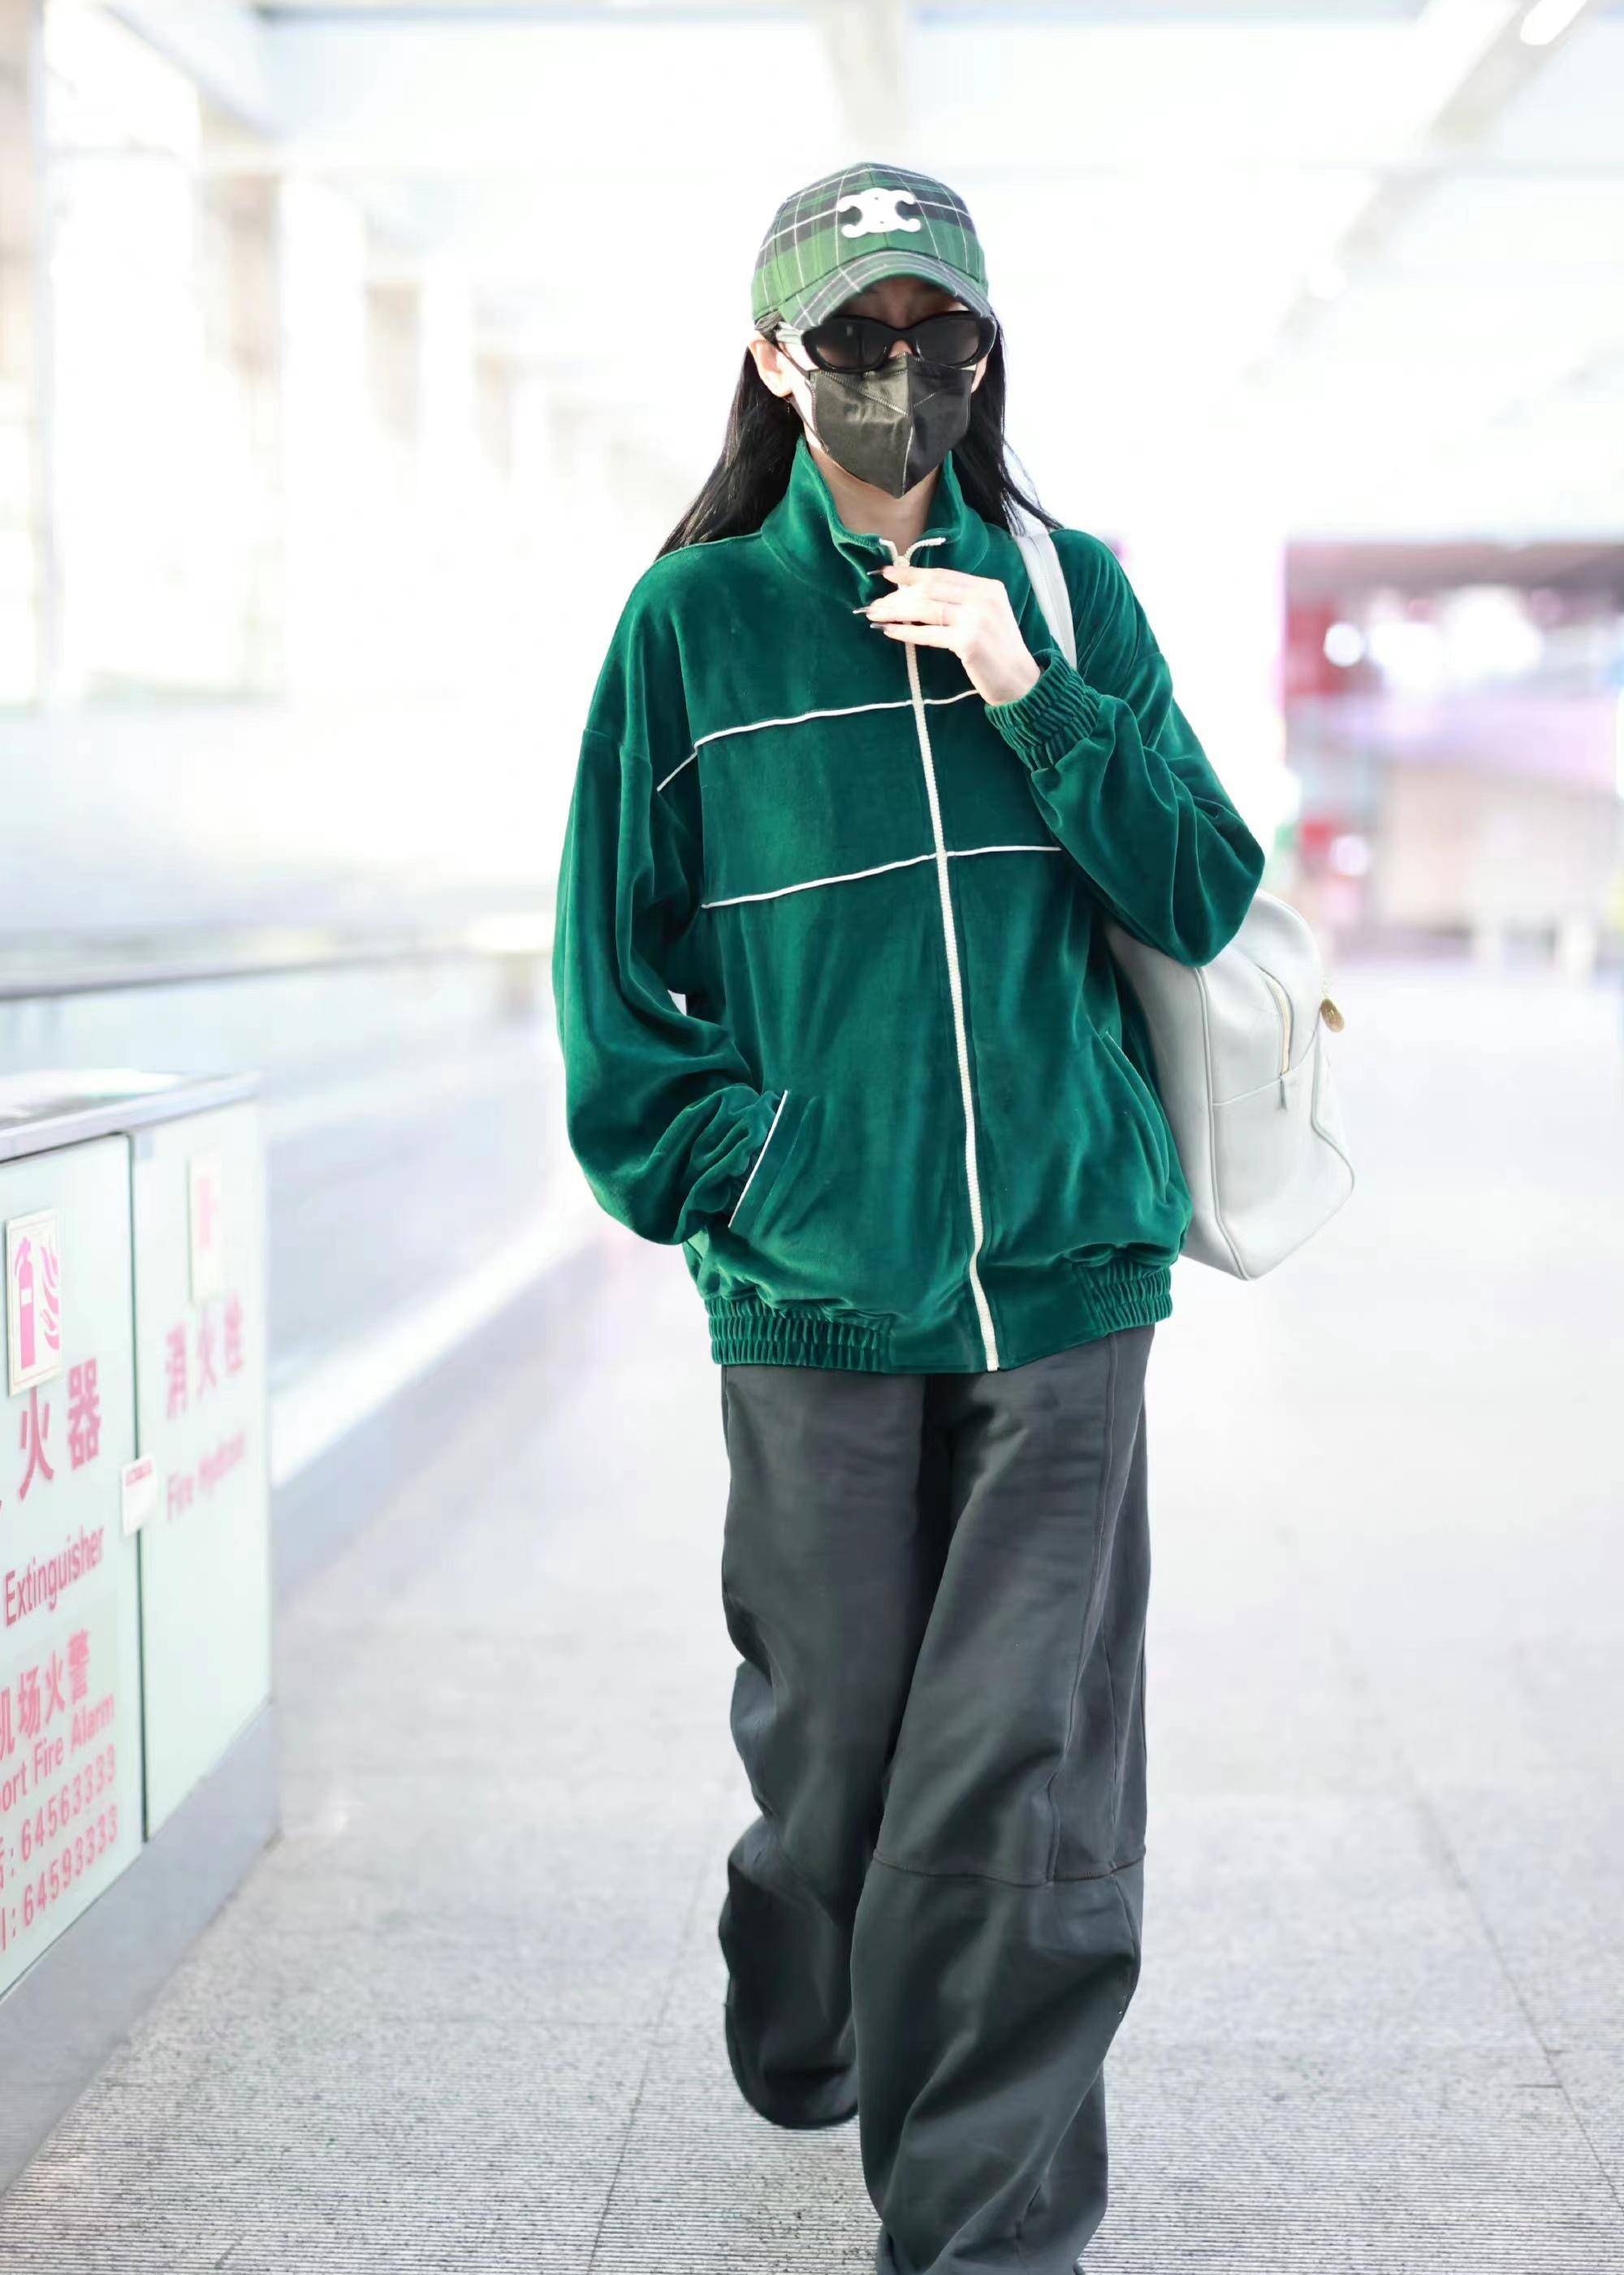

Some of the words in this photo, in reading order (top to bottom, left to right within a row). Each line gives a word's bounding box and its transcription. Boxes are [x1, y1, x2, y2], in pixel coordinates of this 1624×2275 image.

[0, 1358, 101, 1512] 火器
[5, 1525, 104, 1627] Extinguisher
[0, 1759, 28, 1812] ort
[34, 1736, 64, 1785] Fire
[71, 1692, 114, 1755] Alarm
